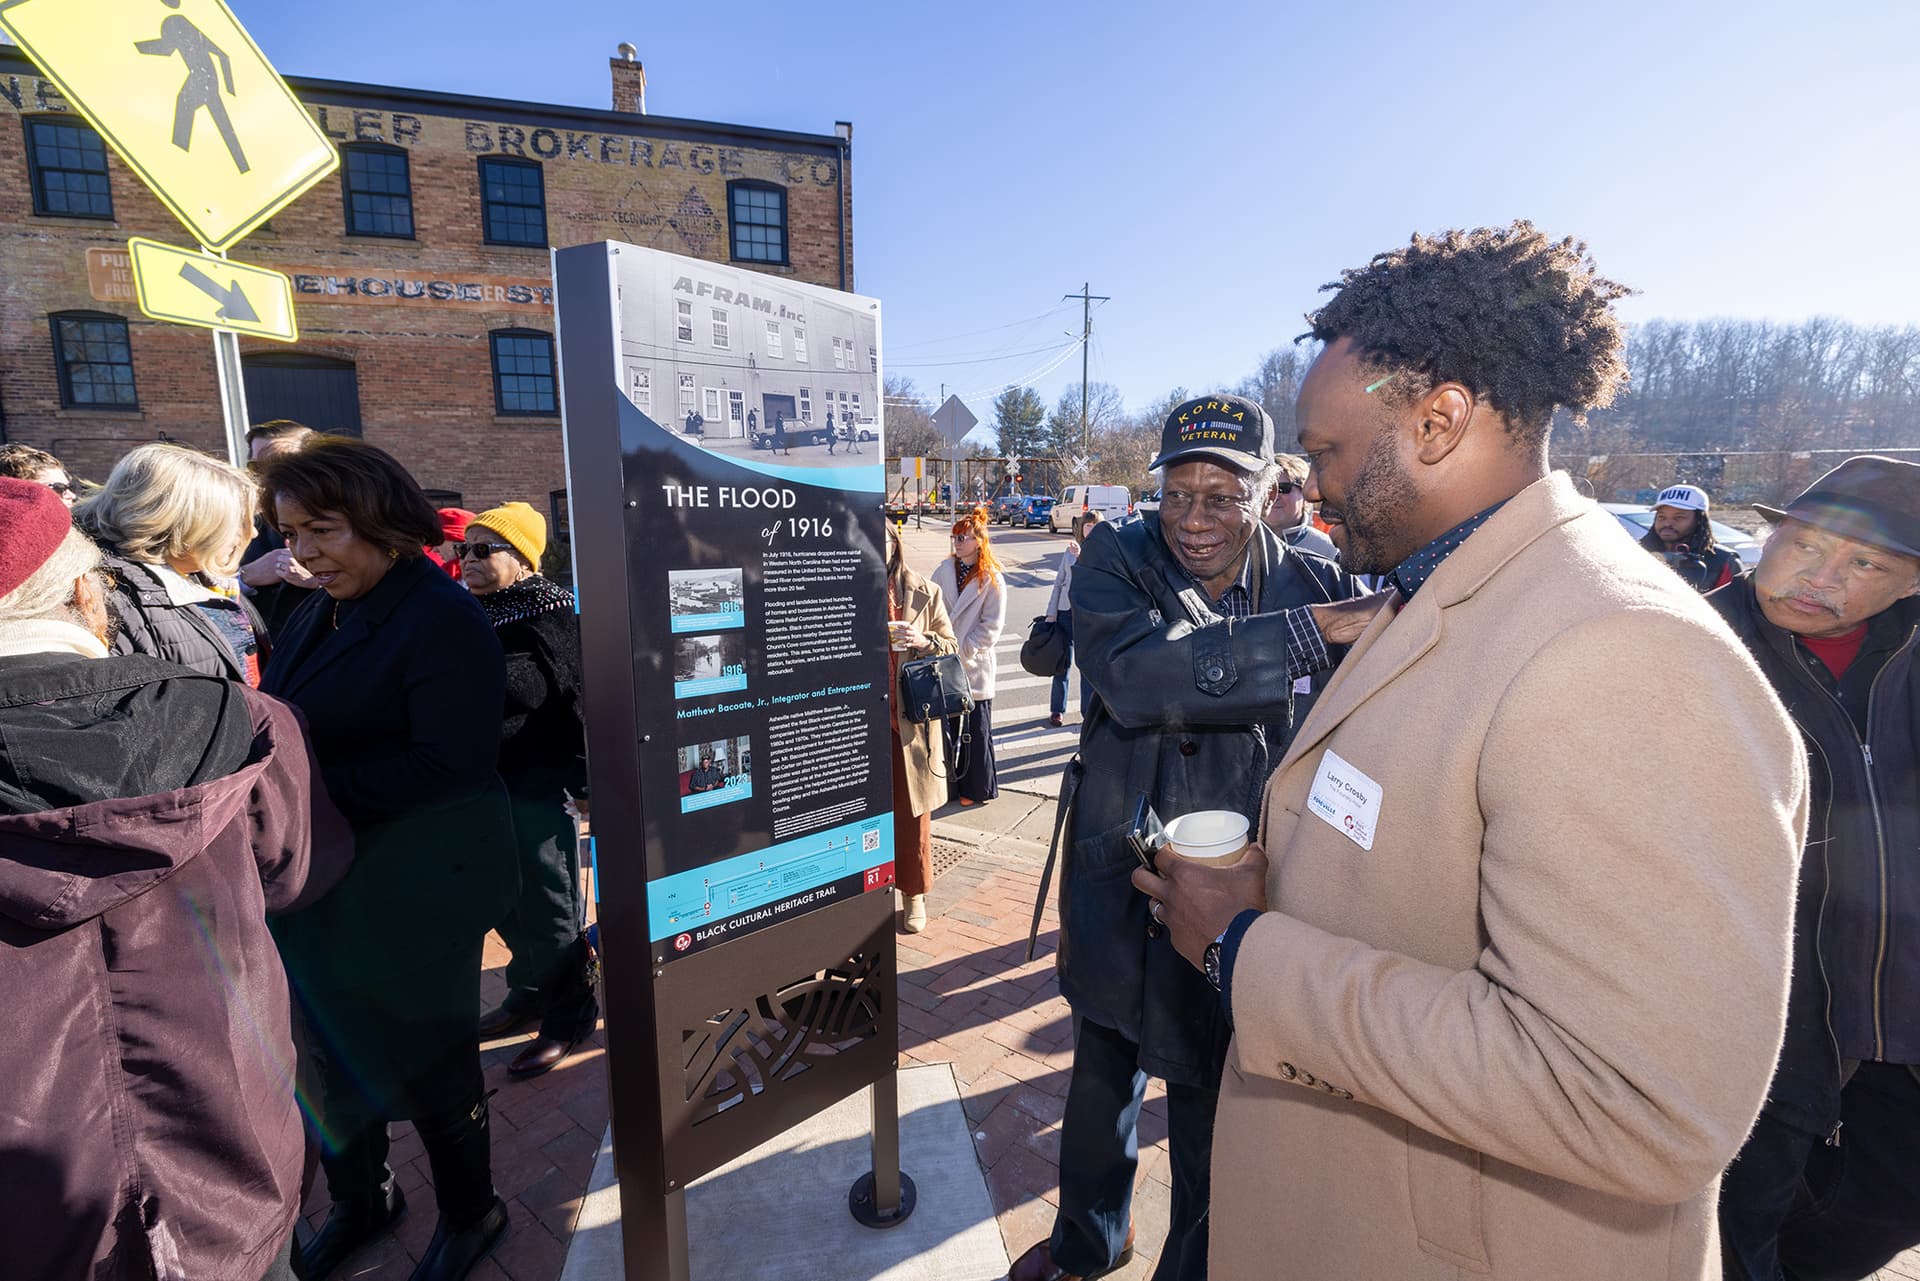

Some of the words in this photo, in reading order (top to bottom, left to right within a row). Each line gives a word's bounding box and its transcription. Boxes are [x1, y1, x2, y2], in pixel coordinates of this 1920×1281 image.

[464, 121, 744, 177] BROKERAGE
[780, 156, 837, 187] CO
[1178, 401, 1245, 425] KOREA
[1181, 431, 1238, 442] VETERAN
[662, 485, 709, 508] THE
[718, 487, 796, 508] FLOOD
[1660, 490, 1690, 502] MUNI
[761, 520, 782, 546] of
[788, 518, 833, 537] 1916
[720, 601, 740, 614] 1916
[722, 664, 743, 678] 1916
[676, 706, 716, 720] Matthew
[718, 700, 755, 714] Bacoate,
[772, 692, 810, 705] Integrator
[812, 690, 826, 698] and
[828, 682, 872, 696] Entrepreneur
[1328, 770, 1344, 788] Larry
[1344, 782, 1368, 805] Crosby
[868, 872, 878, 885] R1
[696, 923, 727, 941] BLACK
[729, 908, 773, 930] CULTURAL
[774, 894, 814, 914] HERITAGE
[815, 886, 836, 900] TRAIL
